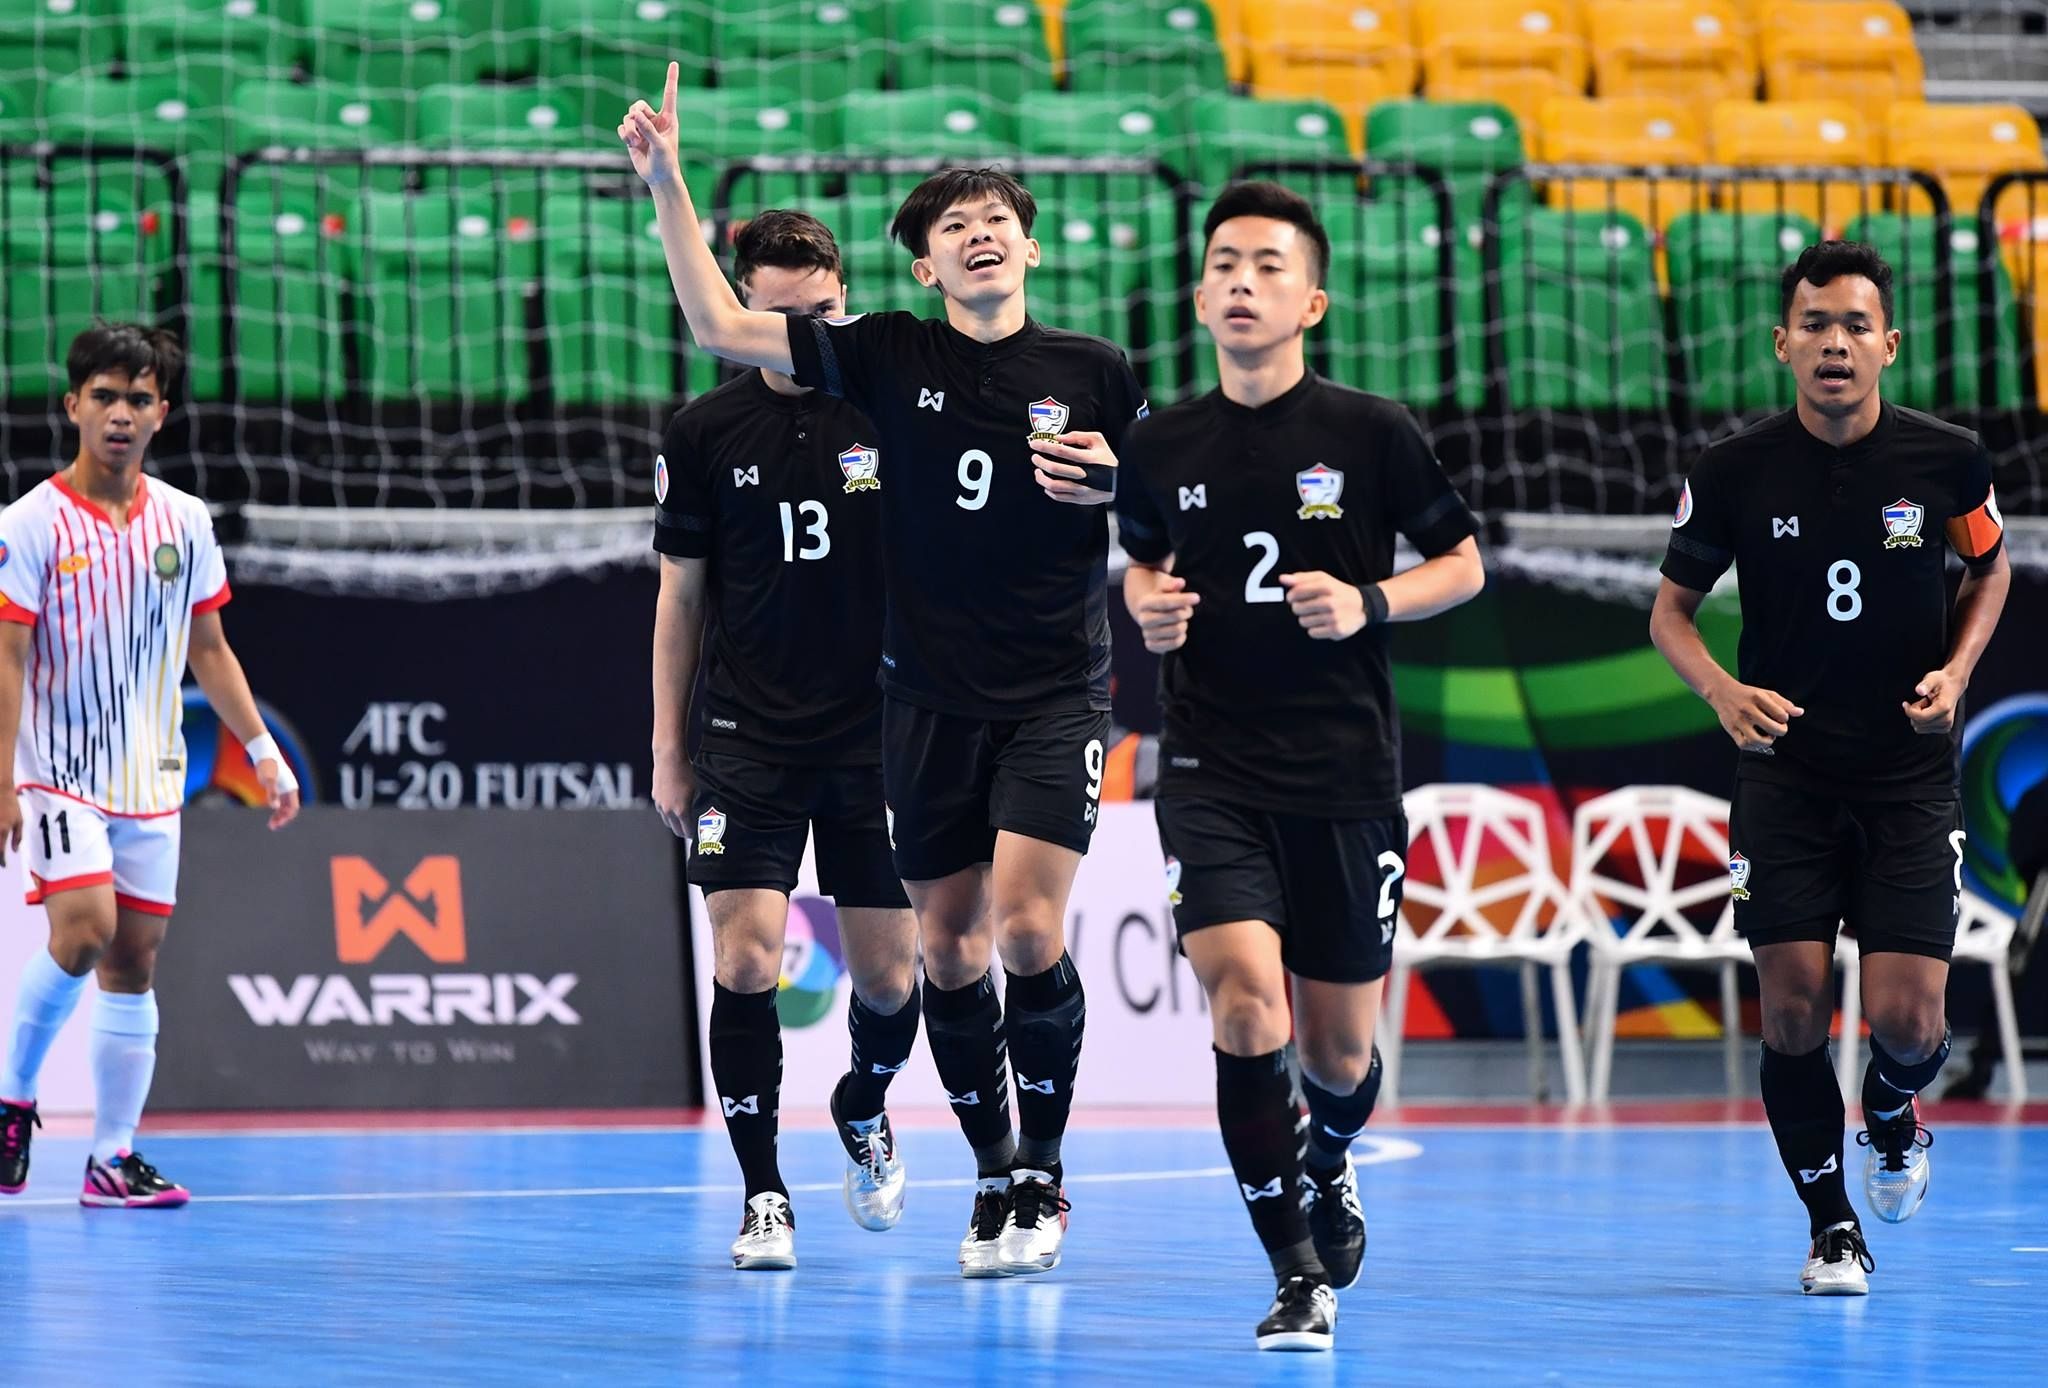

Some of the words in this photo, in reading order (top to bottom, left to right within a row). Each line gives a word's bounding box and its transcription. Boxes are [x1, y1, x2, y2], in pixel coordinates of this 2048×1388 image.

[955, 449, 993, 511] 9
[778, 500, 831, 562] 13
[1242, 531, 1285, 603] 2
[1826, 559, 1862, 622] 8
[341, 701, 448, 756] AFC
[340, 761, 464, 811] U-20
[473, 762, 648, 811] FUTSAL
[39, 810, 71, 860] 11
[1377, 850, 1405, 919] 2
[227, 973, 582, 1026] WARRIX
